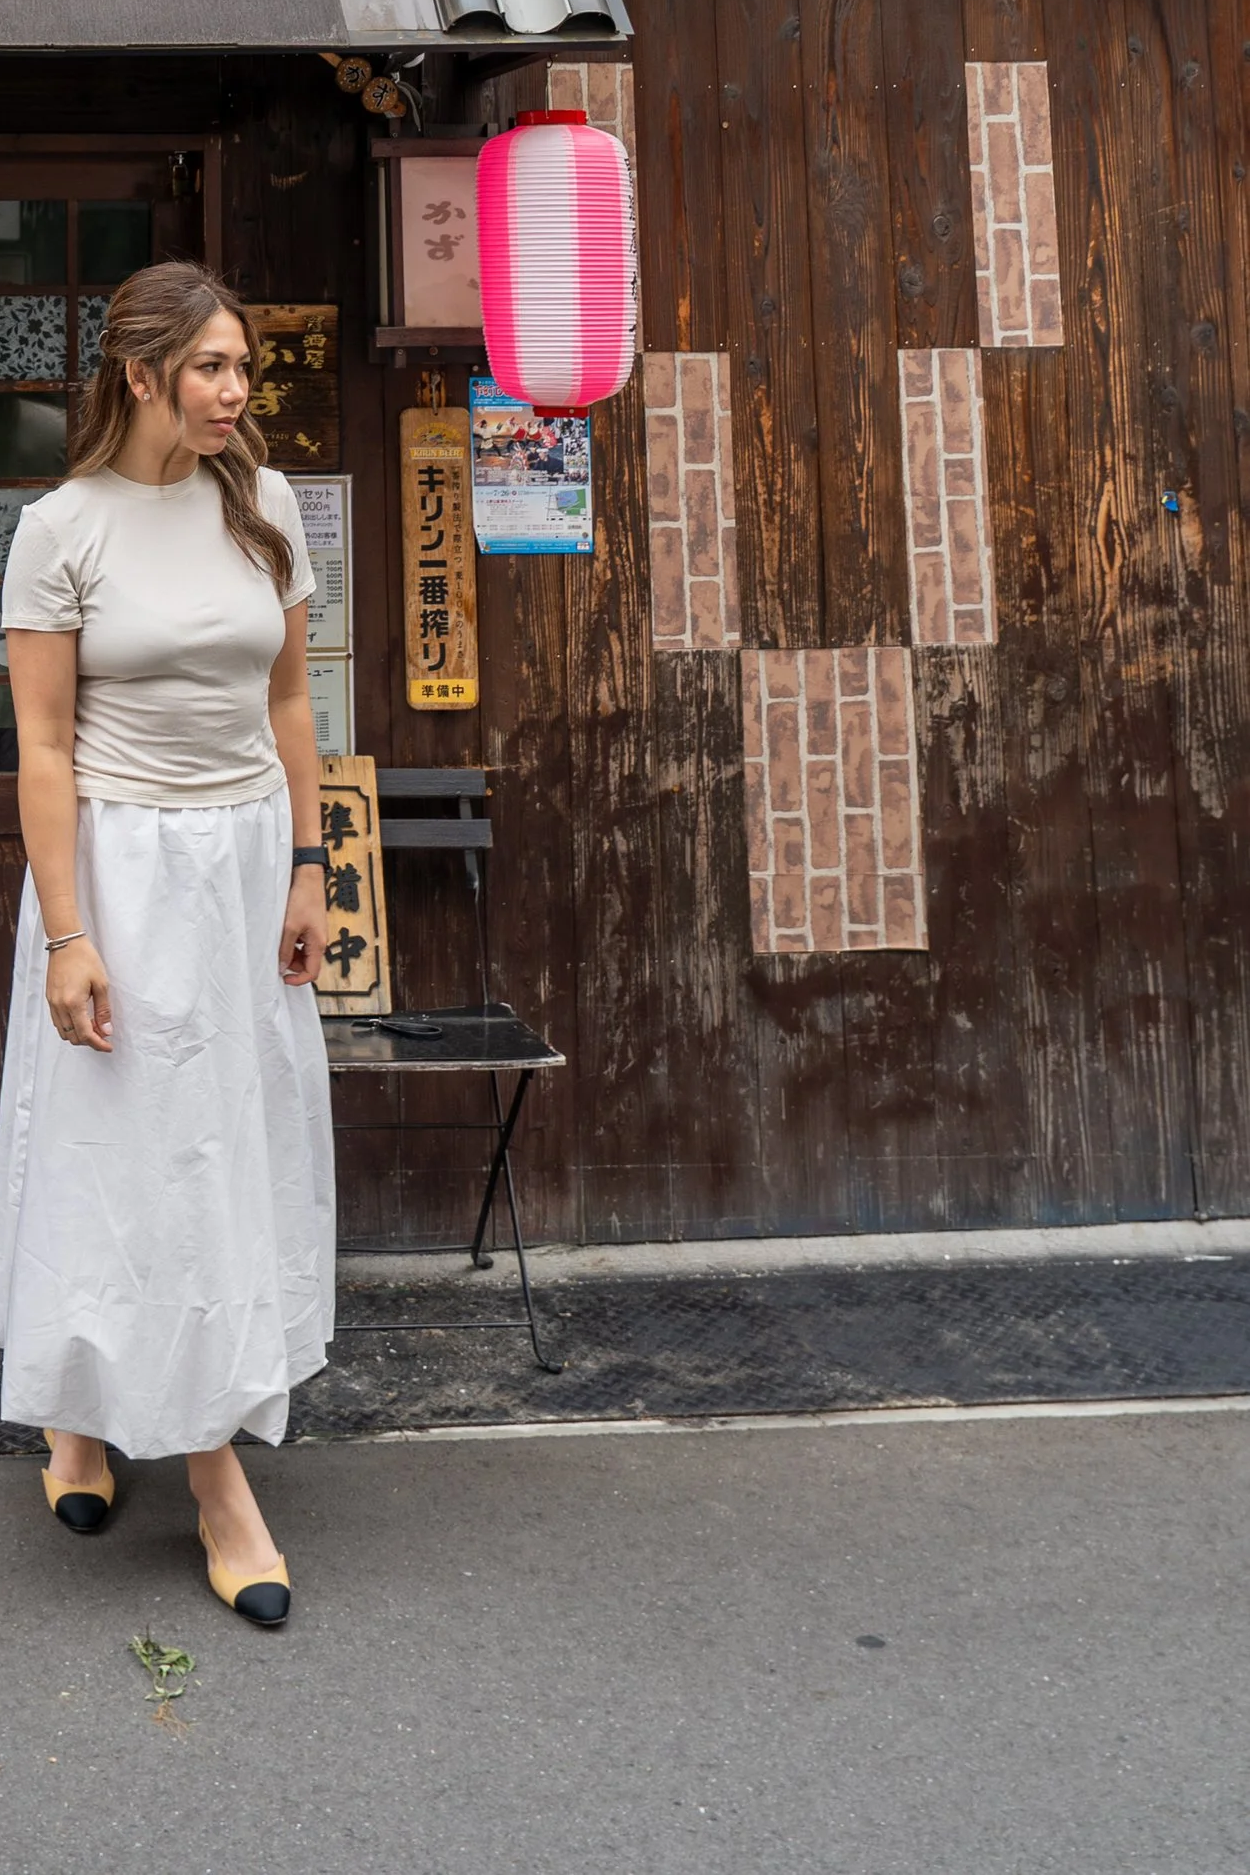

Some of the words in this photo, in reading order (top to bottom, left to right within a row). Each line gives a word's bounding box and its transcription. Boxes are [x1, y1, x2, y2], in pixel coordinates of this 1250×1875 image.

[421, 200, 467, 262] かず
[418, 465, 449, 671] キリン一番搾り
[421, 684, 465, 698] 準備中
[320, 801, 368, 979] 準備中
